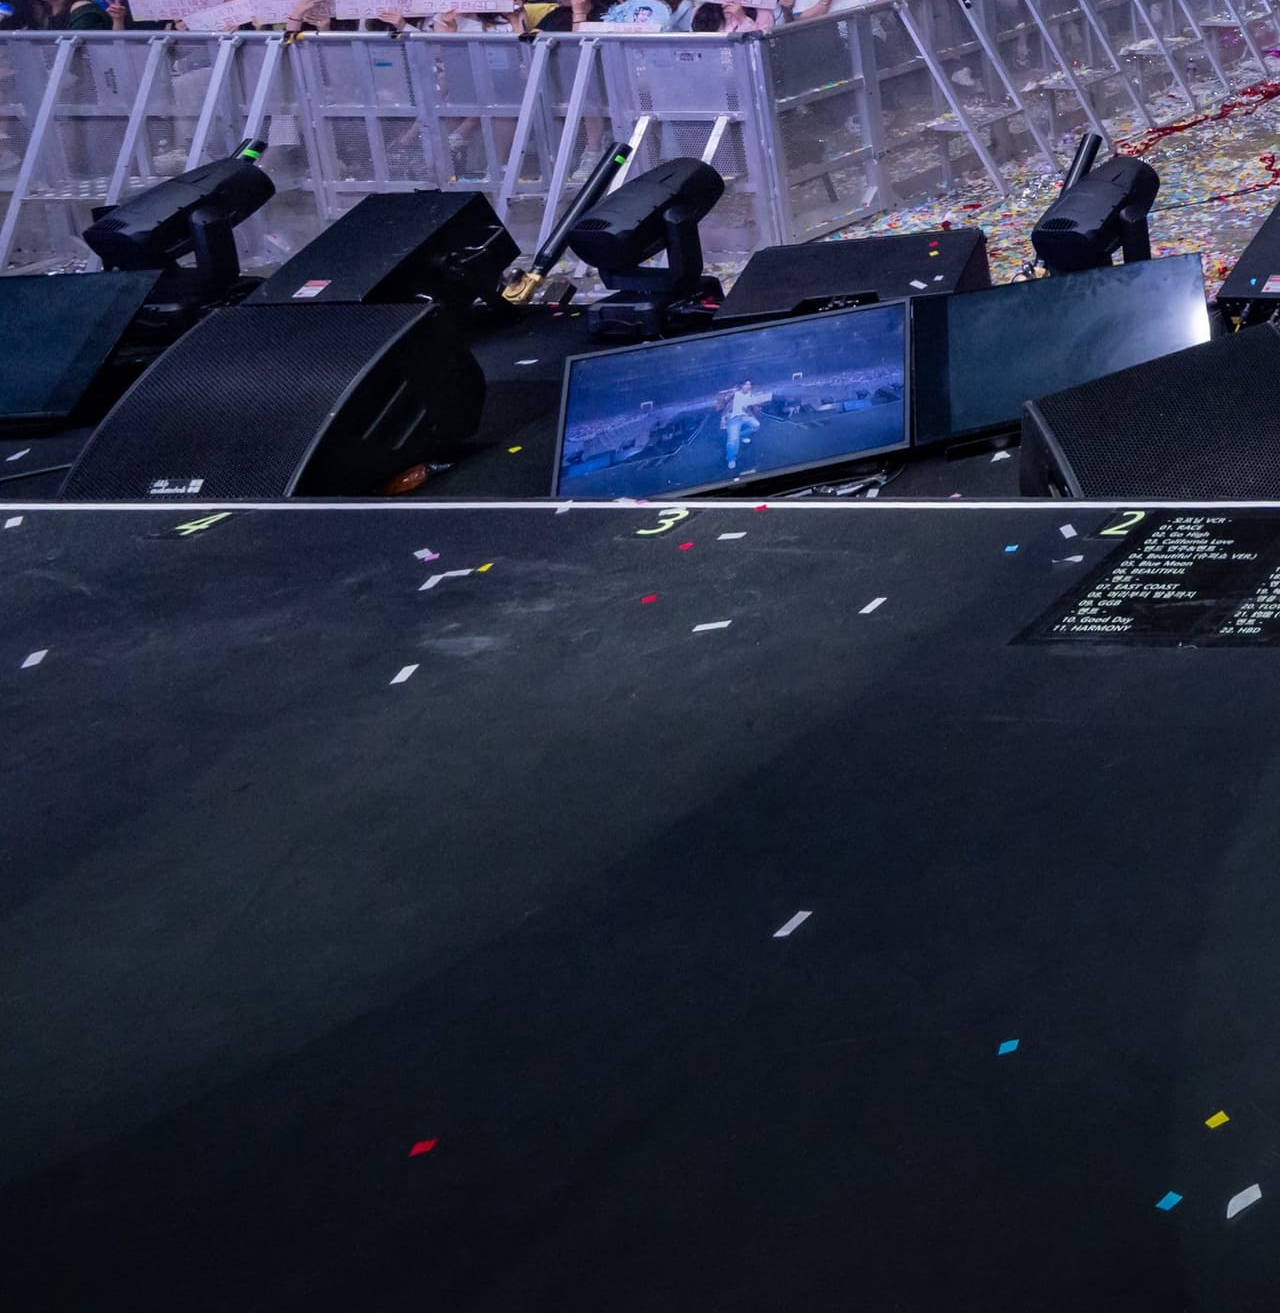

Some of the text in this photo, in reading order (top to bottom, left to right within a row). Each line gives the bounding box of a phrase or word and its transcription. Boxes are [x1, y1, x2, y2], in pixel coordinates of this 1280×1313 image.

[175, 512, 232, 536] 4
[636, 508, 690, 535] 3
[1099, 510, 1146, 536] 2
[1112, 616, 1134, 625] Day
